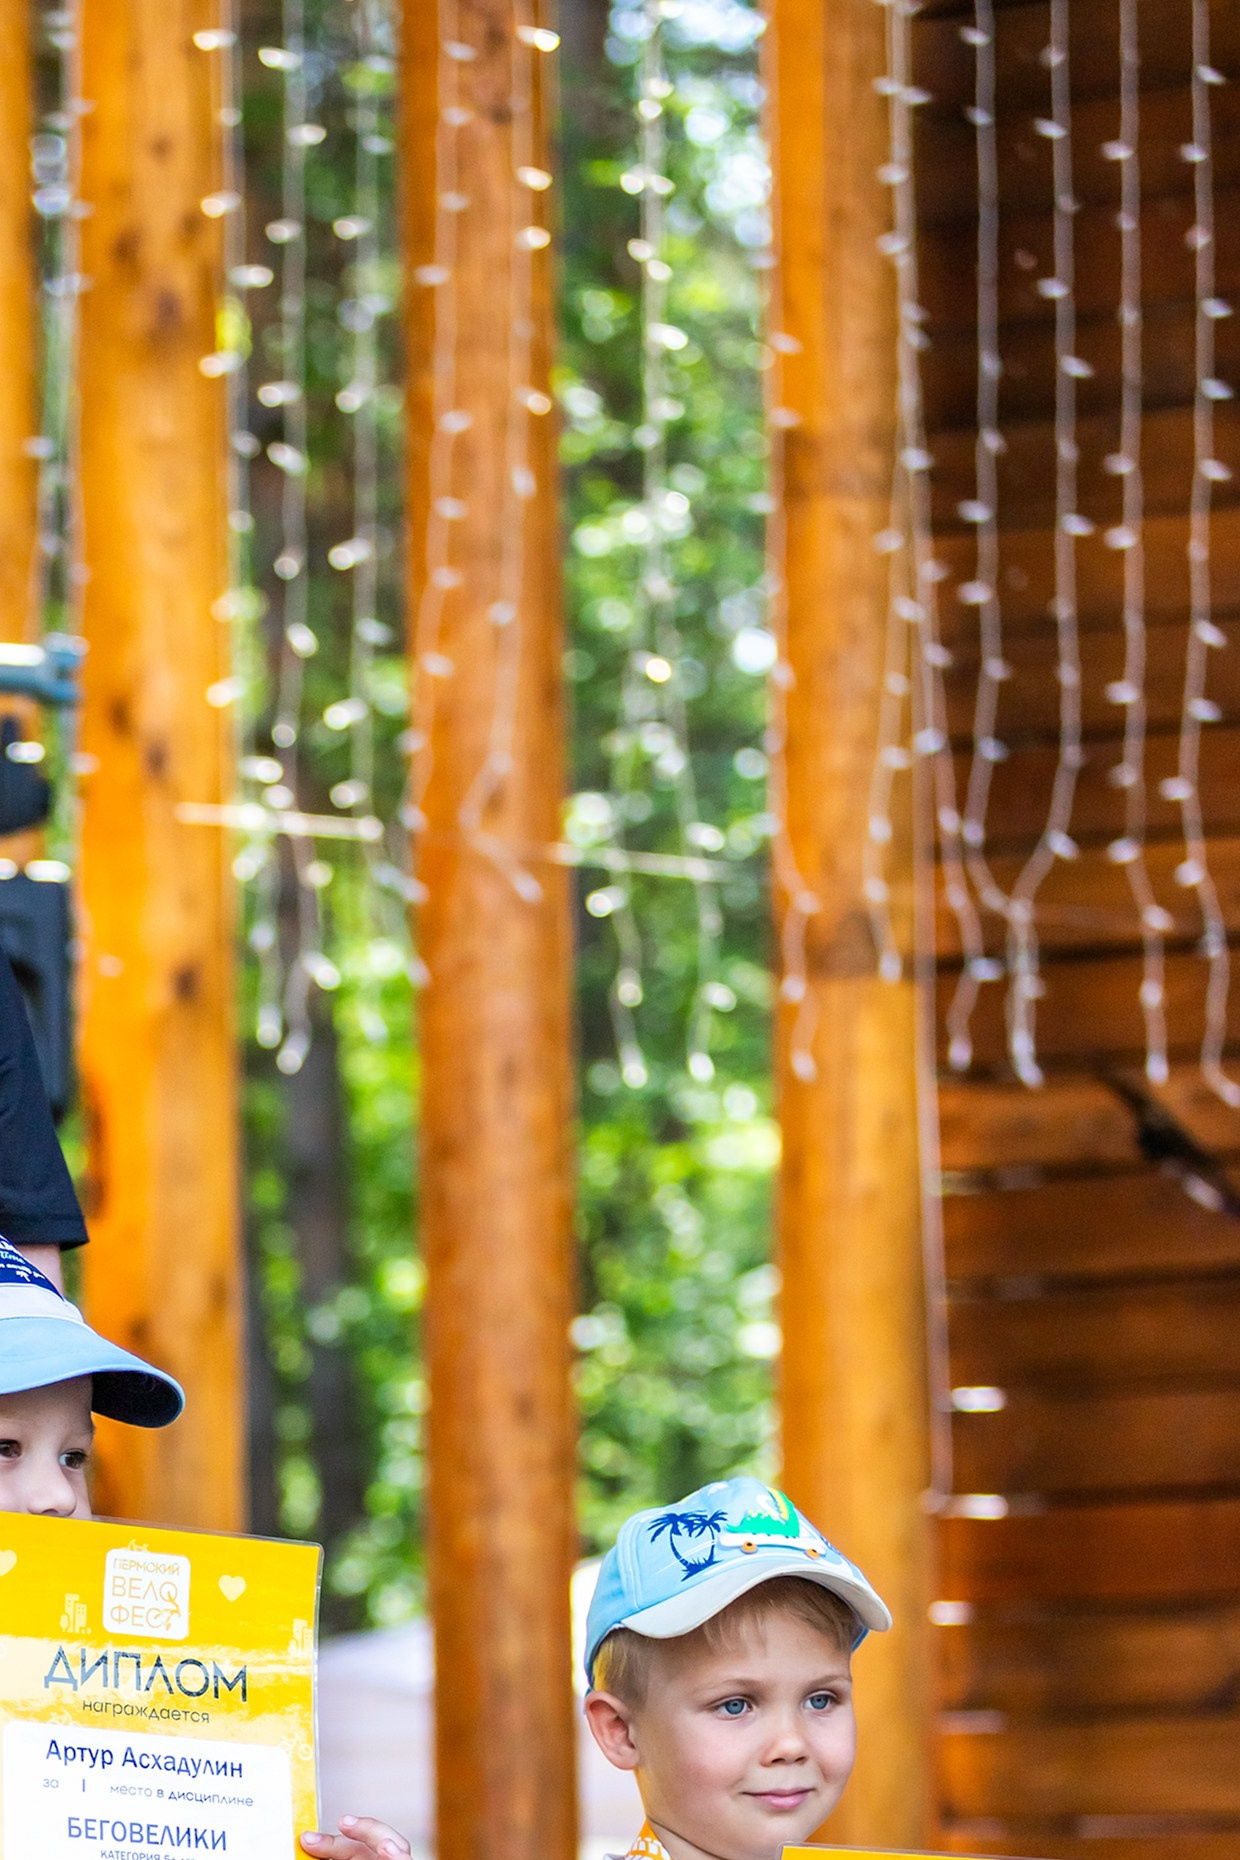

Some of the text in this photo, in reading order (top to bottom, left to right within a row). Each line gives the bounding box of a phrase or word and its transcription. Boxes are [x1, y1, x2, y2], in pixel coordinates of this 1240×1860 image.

[113, 1558, 181, 1576] ПЕРМСКИЙ
[111, 1576, 178, 1602] ВЕЛО
[110, 1604, 181, 1631] ФЕСТ
[44, 1645, 247, 1702] ДИПЛОМ
[82, 1700, 210, 1723] награждается
[46, 1739, 243, 1778] Артур Асхадулин
[43, 1778, 59, 1788] за
[110, 1785, 152, 1797] место
[156, 1789, 165, 1798] в
[168, 1790, 254, 1806] дисциплине
[67, 1817, 228, 1851] БЕГОВЕЛИКИ
